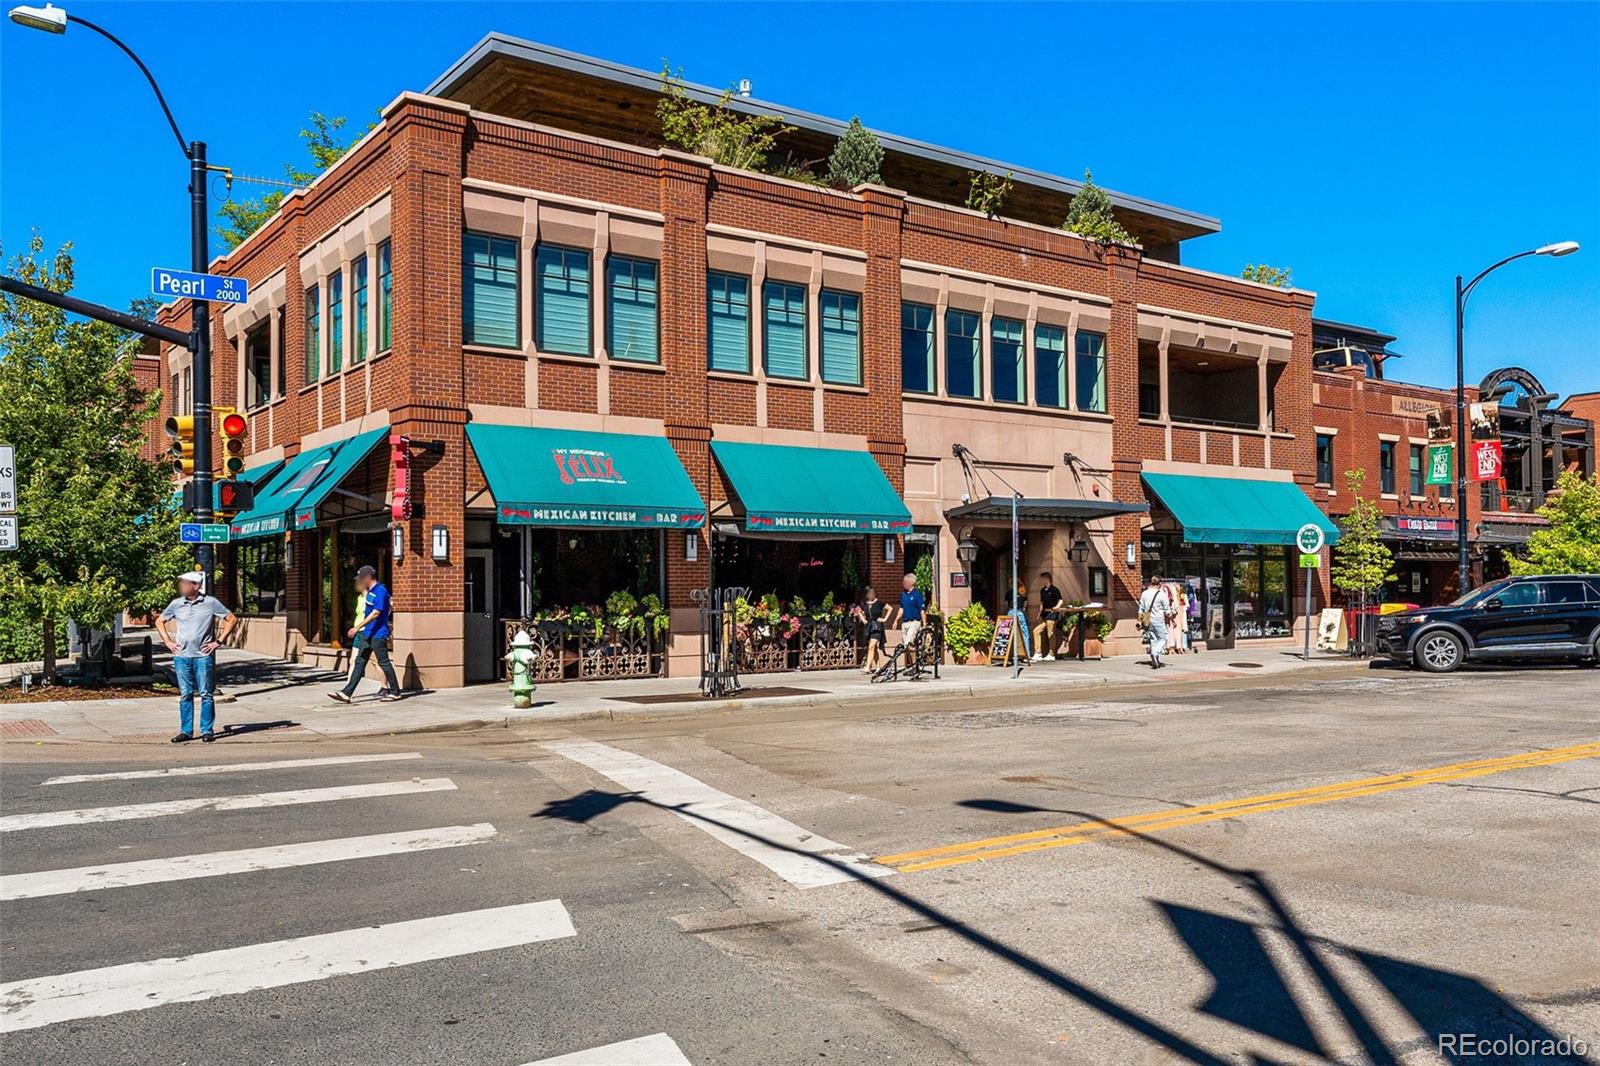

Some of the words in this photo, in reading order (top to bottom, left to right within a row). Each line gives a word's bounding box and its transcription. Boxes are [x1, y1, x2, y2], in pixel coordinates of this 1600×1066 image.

[160, 273, 205, 296] Pearl
[223, 279, 233, 289] St
[216, 289, 240, 300] 2000
[1433, 453, 1448, 463] WEST
[1477, 449, 1497, 460] WEST
[1434, 463, 1448, 474] END
[1478, 459, 1496, 471] END
[533, 508, 588, 520] MEXICAN
[590, 511, 636, 521] KITCHEN
[656, 513, 678, 523] BAR
[775, 517, 818, 527] MEXICAN
[819, 519, 857, 528] KITCHEN
[871, 520, 889, 529] BAR
